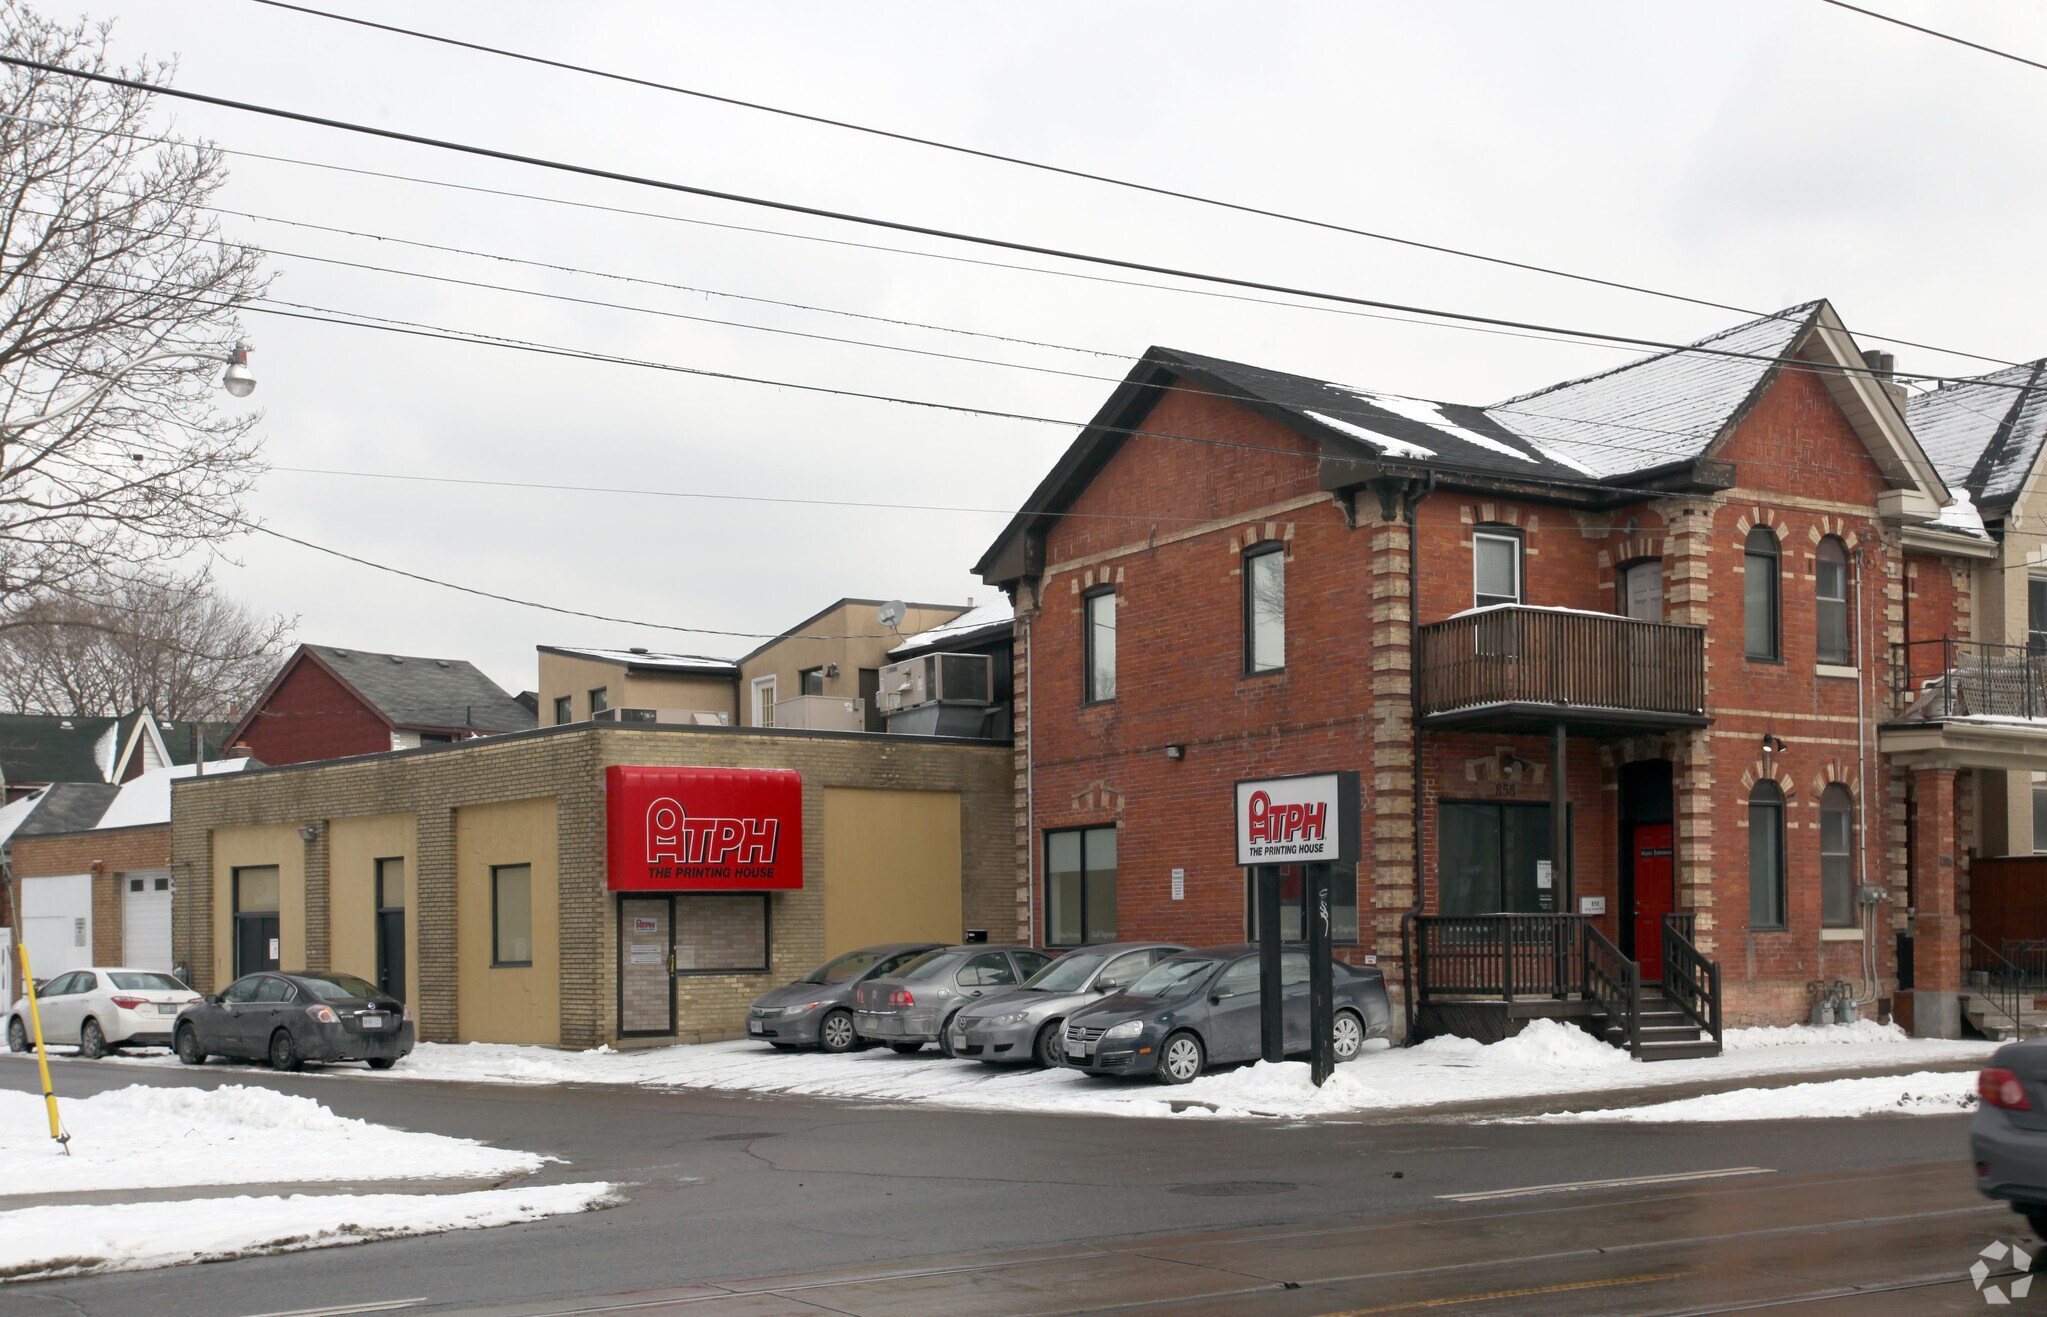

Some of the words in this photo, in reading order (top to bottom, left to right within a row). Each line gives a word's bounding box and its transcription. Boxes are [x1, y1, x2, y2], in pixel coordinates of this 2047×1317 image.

[1495, 784, 1516, 796] 858
[1249, 847, 1263, 856] THE
[1264, 845, 1297, 855] PRINTING
[1298, 843, 1324, 854] HOUSE
[649, 867, 672, 878] THE
[675, 867, 731, 879] PRINTING
[735, 867, 775, 878] HOUSE
